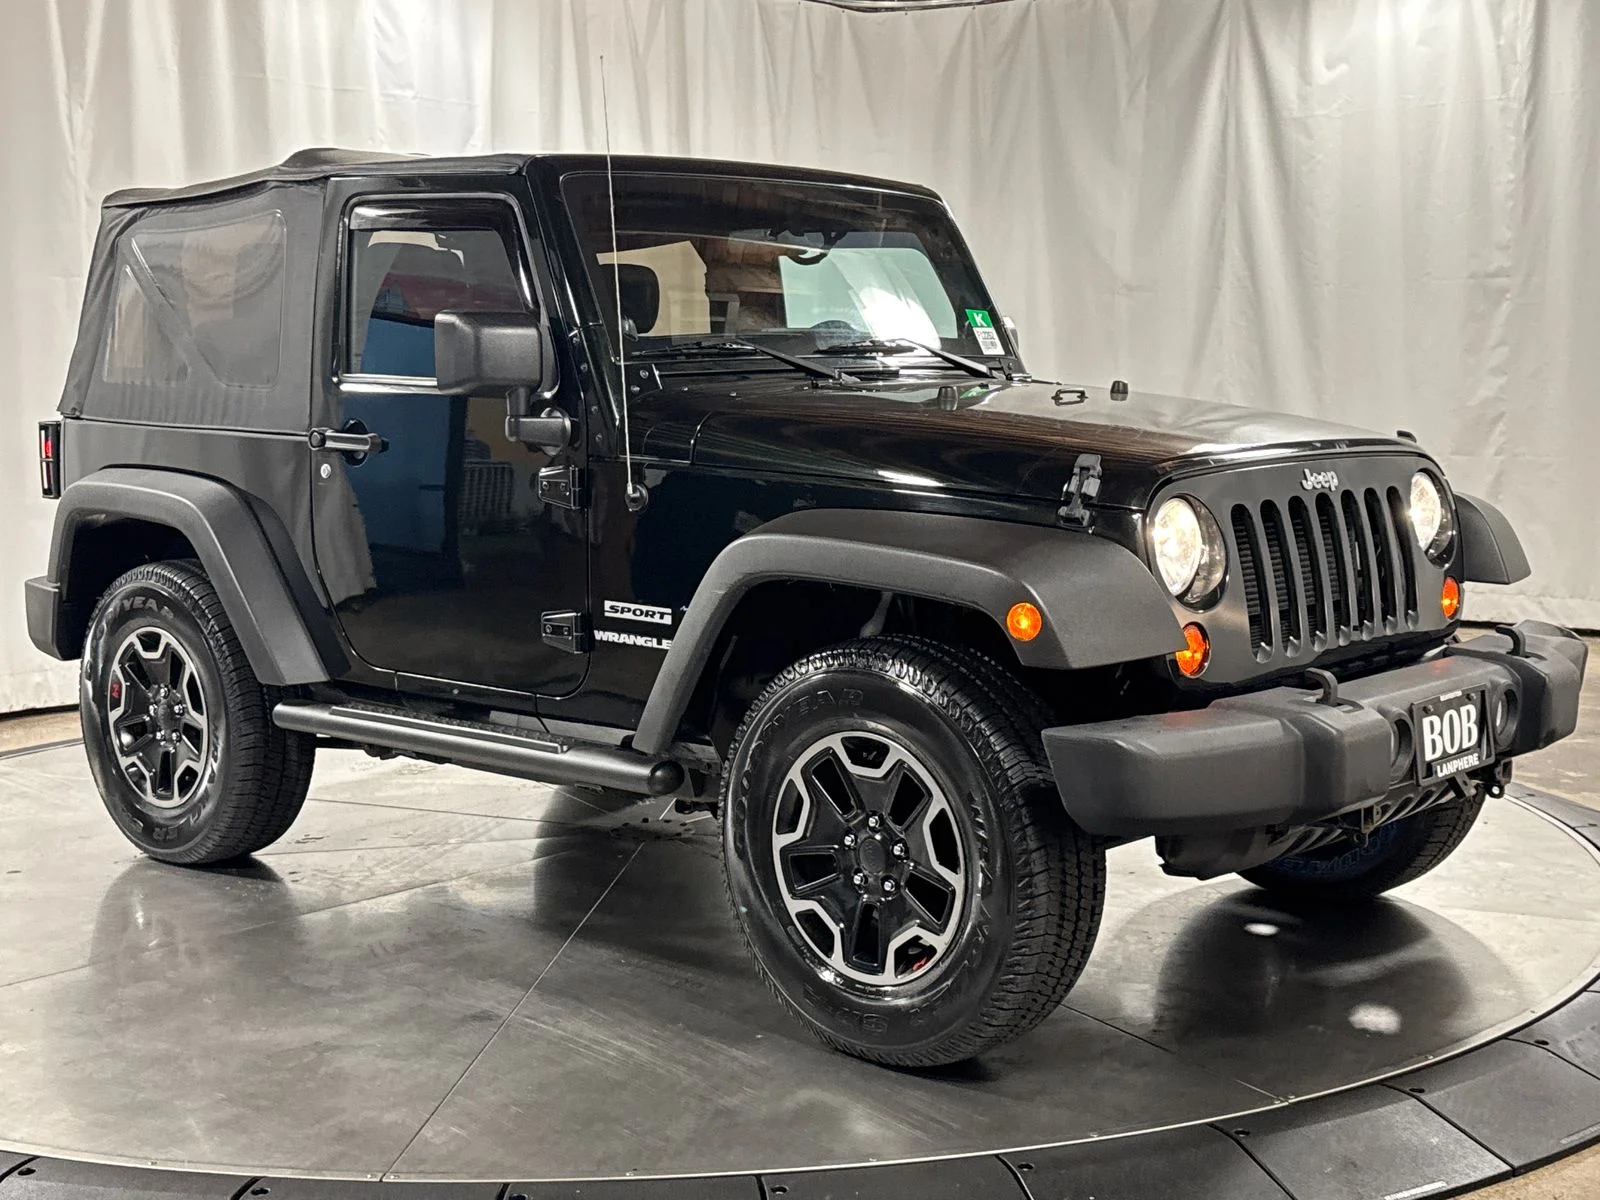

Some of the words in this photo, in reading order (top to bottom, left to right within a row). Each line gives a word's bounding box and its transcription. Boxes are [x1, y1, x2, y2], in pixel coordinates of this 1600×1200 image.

[973, 312, 988, 327] K
[1301, 468, 1339, 492] Jeep
[604, 603, 672, 621] SPORT
[1422, 704, 1478, 762] BOB
[1436, 753, 1480, 778] LANPHERE
